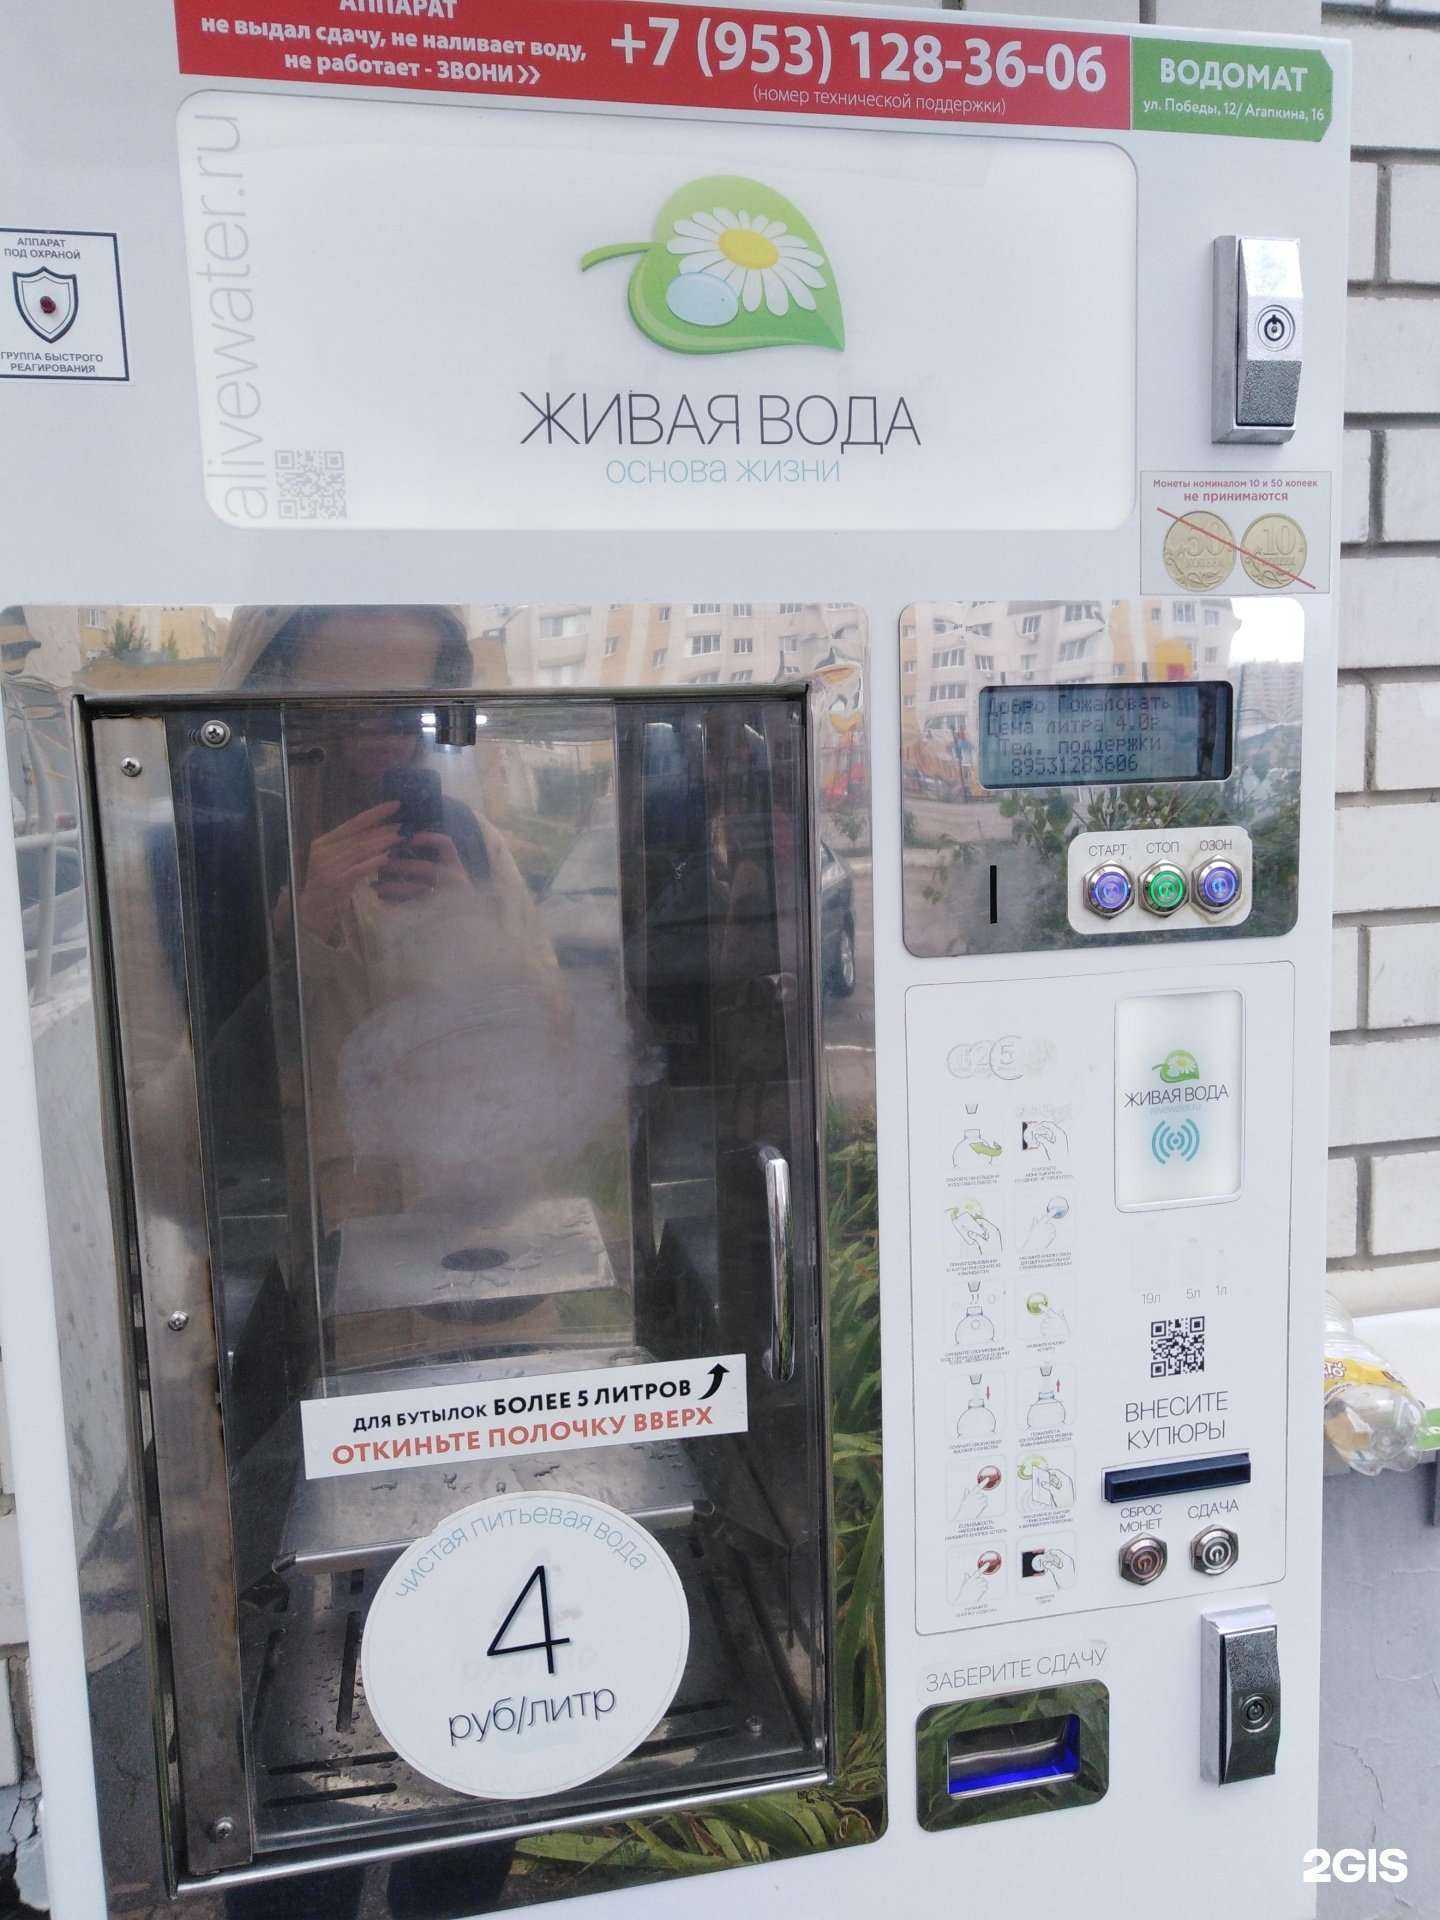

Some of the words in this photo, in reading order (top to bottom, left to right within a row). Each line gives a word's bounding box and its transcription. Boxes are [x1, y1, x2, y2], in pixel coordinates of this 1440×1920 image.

[201, 17, 228, 34] не
[234, 20, 311, 41] выдал
[316, 26, 387, 48] сдачу,
[391, 31, 418, 48] не
[423, 34, 524, 56] наливает
[531, 41, 587, 62] воду,
[284, 51, 311, 70] не
[317, 54, 420, 78] работает
[611, 16, 680, 66] +7
[697, 17, 832, 85] (953)
[850, 31, 1107, 92] 128-36-06
[1160, 58, 1308, 92] ВОДОМАТ
[753, 83, 810, 105] (номер
[813, 89, 912, 110] технической
[916, 96, 1006, 116] поддержки)
[1143, 99, 1161, 113] ул.
[1164, 98, 1221, 116] Победы,
[1224, 103, 1243, 119] 12/
[1245, 104, 1308, 121] Агапкина,
[1312, 108, 1325, 121] 16
[4, 248, 28, 259] ПОД
[30, 249, 81, 260] ОХРАНОЙ
[17, 237, 66, 248] АППАРАТ
[194, 115, 268, 519] alivewater.ru
[0, 351, 42, 361] ГРУППА
[45, 353, 104, 363] БЫСТРОГО
[10, 363, 96, 374] РЕАГИРОВАНИЯ
[519, 391, 740, 445] ЖИВАЯ
[759, 394, 922, 455] ВОДА
[606, 458, 728, 485] основа
[736, 459, 841, 483] жизни
[1153, 479, 1191, 488] Монеты
[1193, 479, 1247, 488] номиналом
[1250, 479, 1260, 488] 10
[1262, 480, 1269, 488] и
[1270, 479, 1283, 488] 50
[1285, 480, 1318, 489] копеек
[1184, 492, 1200, 501] не
[1203, 492, 1289, 503] принимаются
[1001, 738, 1042, 756] Тел.
[1058, 735, 1162, 755] поддержки
[1011, 754, 1139, 777] 89531283606
[1088, 843, 1128, 857] СТАРТ
[1146, 841, 1180, 854] СТОП
[1200, 839, 1233, 852] ОЗОН
[1124, 1088, 1181, 1108] ЖИВАЯ
[1185, 1083, 1229, 1103] ВОДА
[1142, 1293, 1161, 1304] 19л
[1186, 1288, 1201, 1299] 5л
[1215, 1285, 1227, 1296] 1л
[353, 1414, 391, 1433] ДЛЯ
[396, 1404, 488, 1427] БУТЫЛОК
[494, 1391, 571, 1417] БОЛЕЕ
[577, 1389, 589, 1408] 5
[594, 1379, 692, 1405] ЛИТРОВ
[1125, 1391, 1229, 1423] ВНЕСИТЕ
[332, 1431, 480, 1466] ОТКИНЬТЕ
[488, 1414, 626, 1449] ПОЛОЧКУ
[634, 1405, 715, 1433] ВВЕРХ
[1128, 1420, 1226, 1451] КУПЮРЫ
[1120, 1504, 1163, 1519] СБРОС
[1187, 1499, 1240, 1520] СДАЧА
[1119, 1518, 1163, 1533] МОНЕТ
[394, 1527, 469, 1600] чистая
[470, 1506, 594, 1538] питьевая
[593, 1522, 648, 1571] вода
[486, 1564, 571, 1674] 4
[925, 1658, 1032, 1693] ЗАБЕРИТЕ
[1036, 1647, 1108, 1676] СДАЧУ
[448, 1688, 617, 1747] руб/литр
